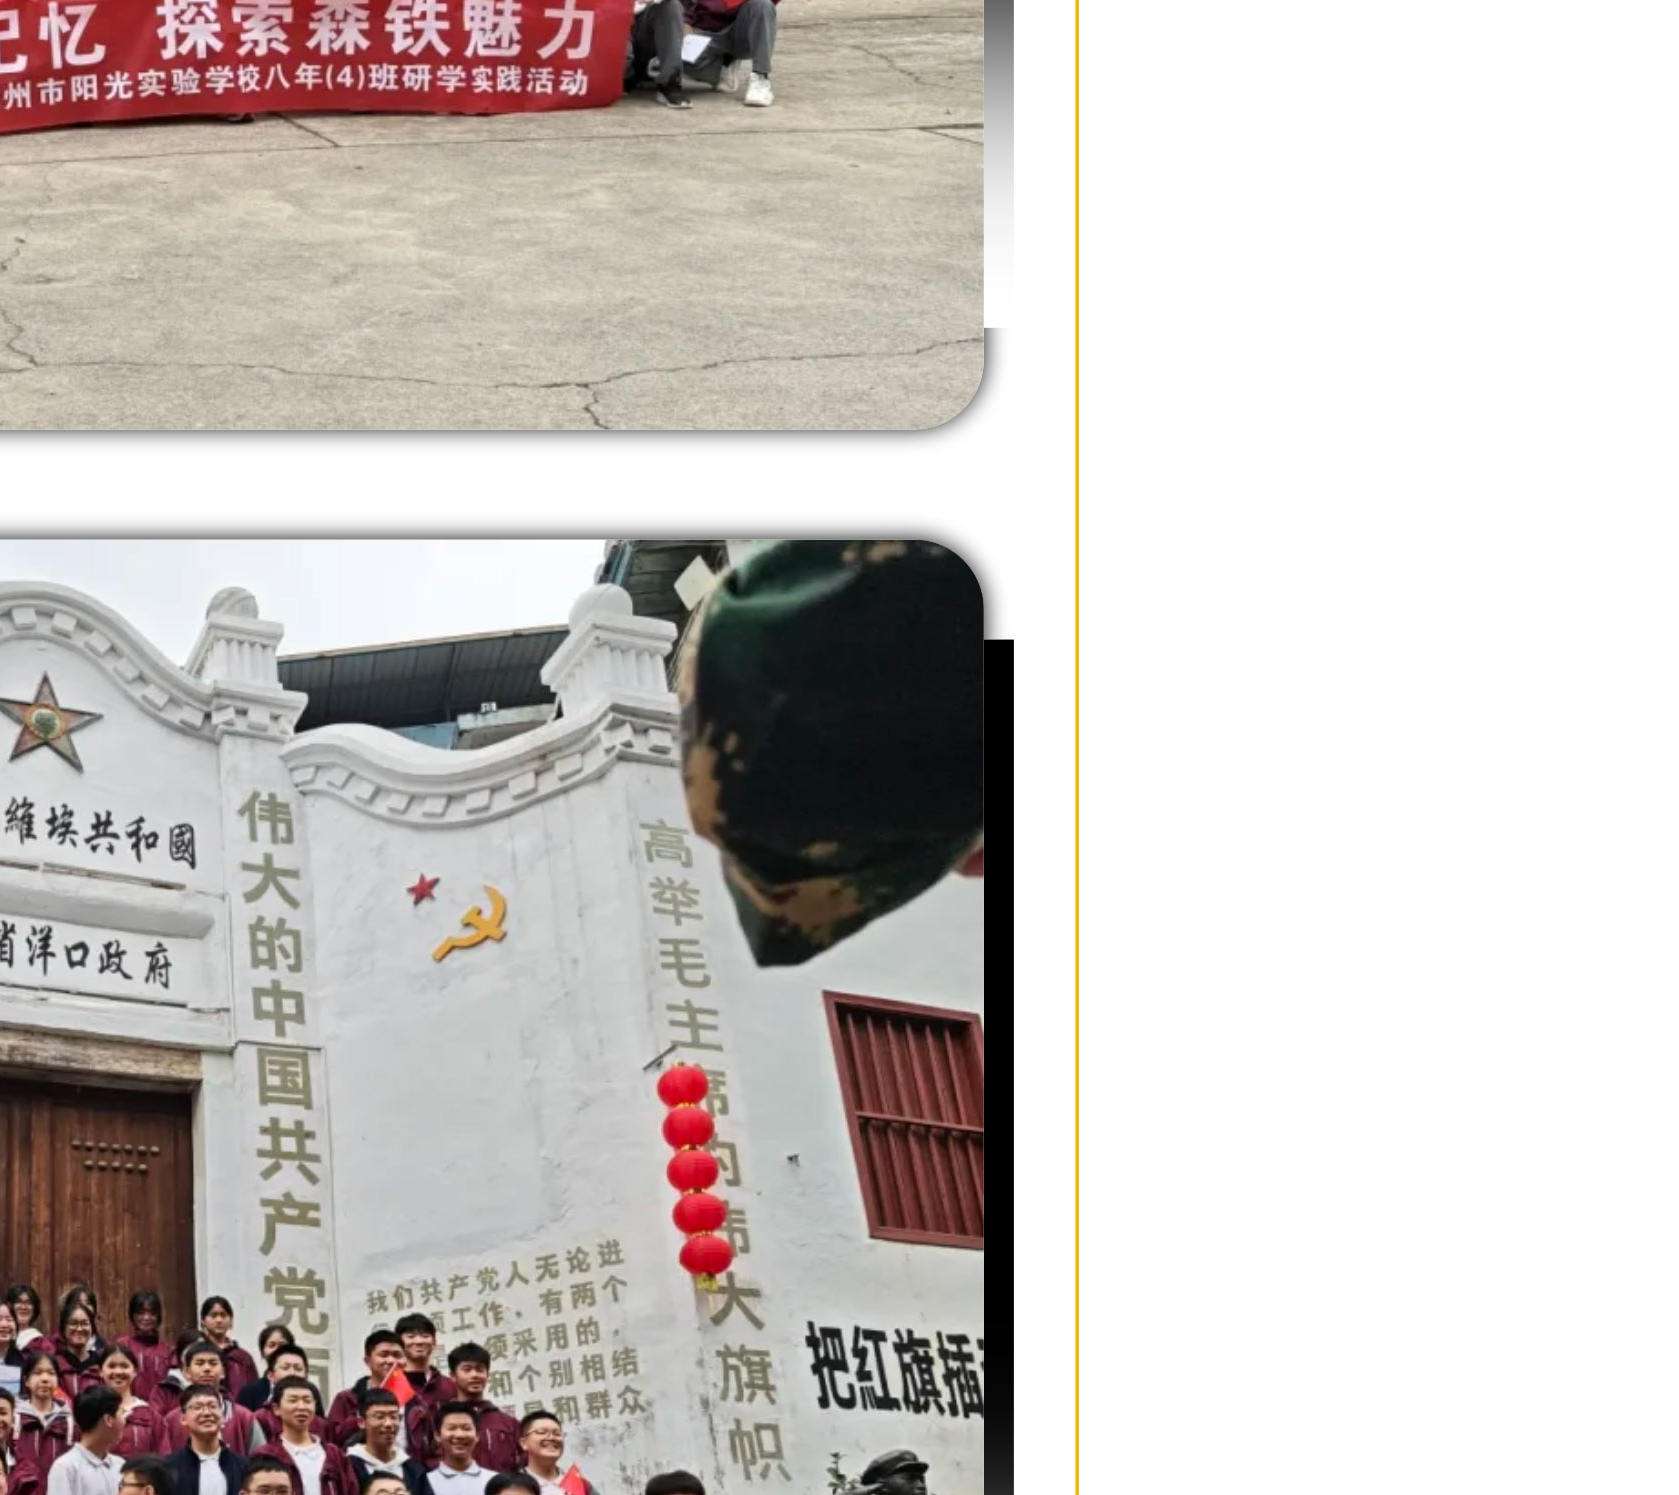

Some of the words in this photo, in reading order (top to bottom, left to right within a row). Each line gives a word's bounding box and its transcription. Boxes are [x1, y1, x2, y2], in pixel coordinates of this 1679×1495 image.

[366, 1239, 626, 1315] 我们共产党人无论进
[805, 1320, 984, 1419] 把紅旗插
